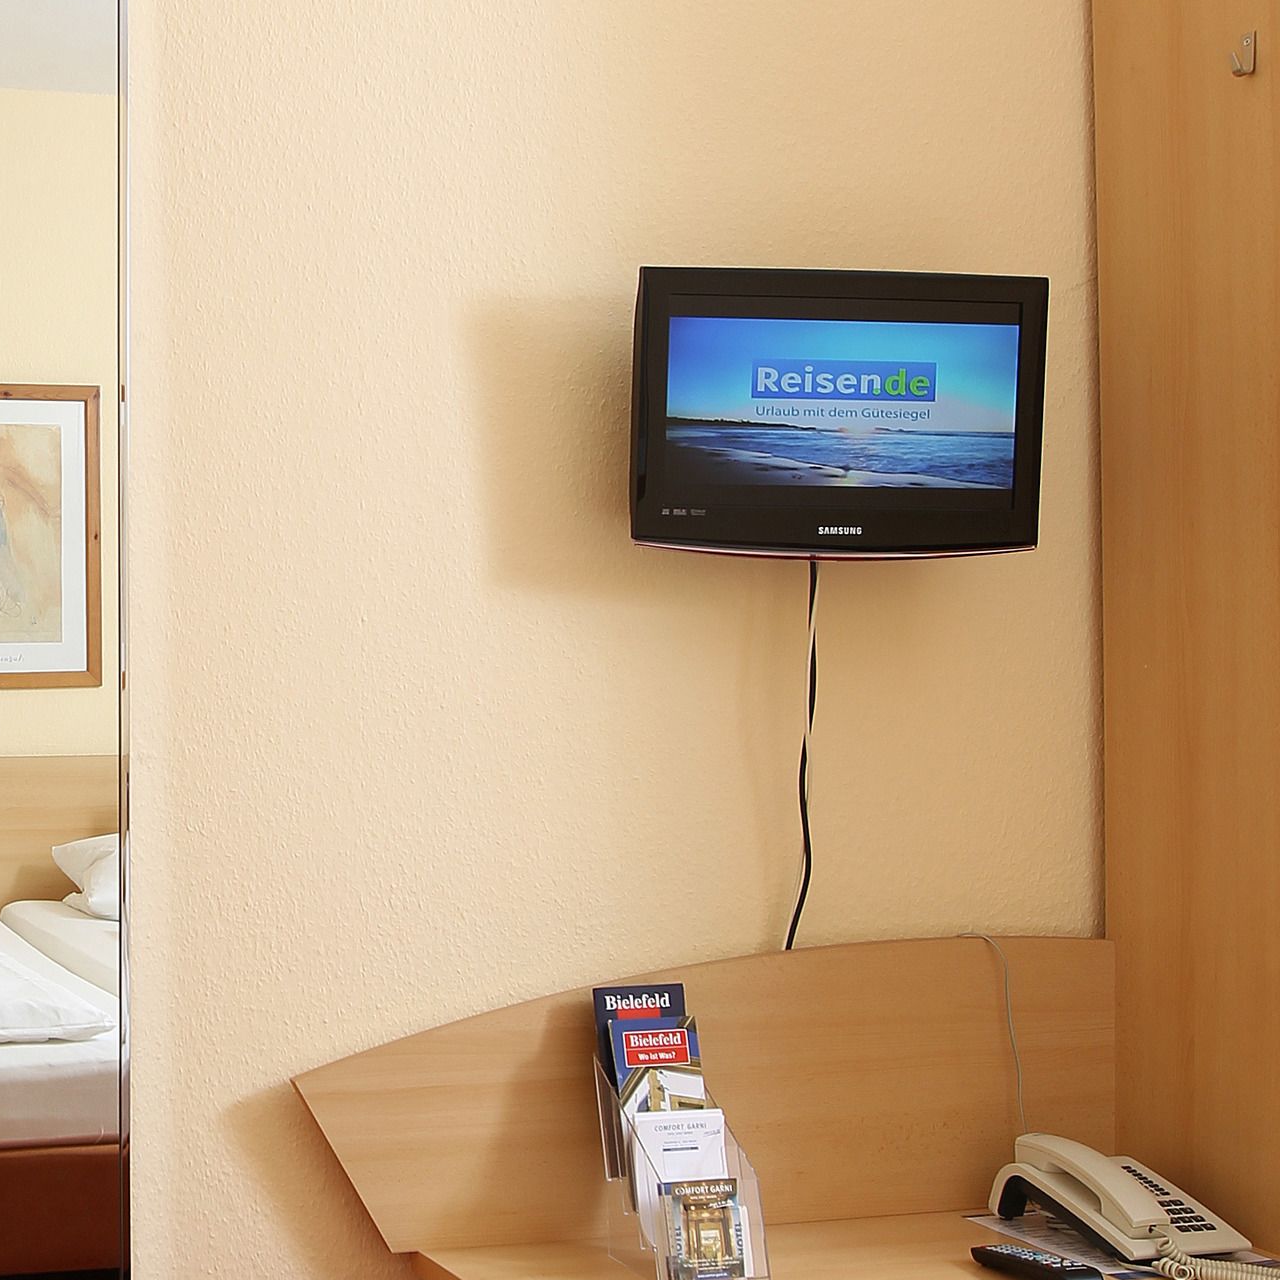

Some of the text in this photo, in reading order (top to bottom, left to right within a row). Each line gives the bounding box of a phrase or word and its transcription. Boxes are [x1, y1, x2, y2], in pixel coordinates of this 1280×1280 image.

[755, 405, 931, 422] Urlaub mit dem Gütesiegel
[818, 526, 862, 535] SAMSUNG
[604, 992, 671, 1011] Bielefeld
[629, 1032, 682, 1048] Bielefeld
[638, 1053, 649, 1061] Wo
[659, 1051, 676, 1060] Was?
[654, 1122, 685, 1132] COMFORT
[675, 1184, 733, 1196] COMFORT GARNI
[734, 1221, 744, 1257] HOTEL
